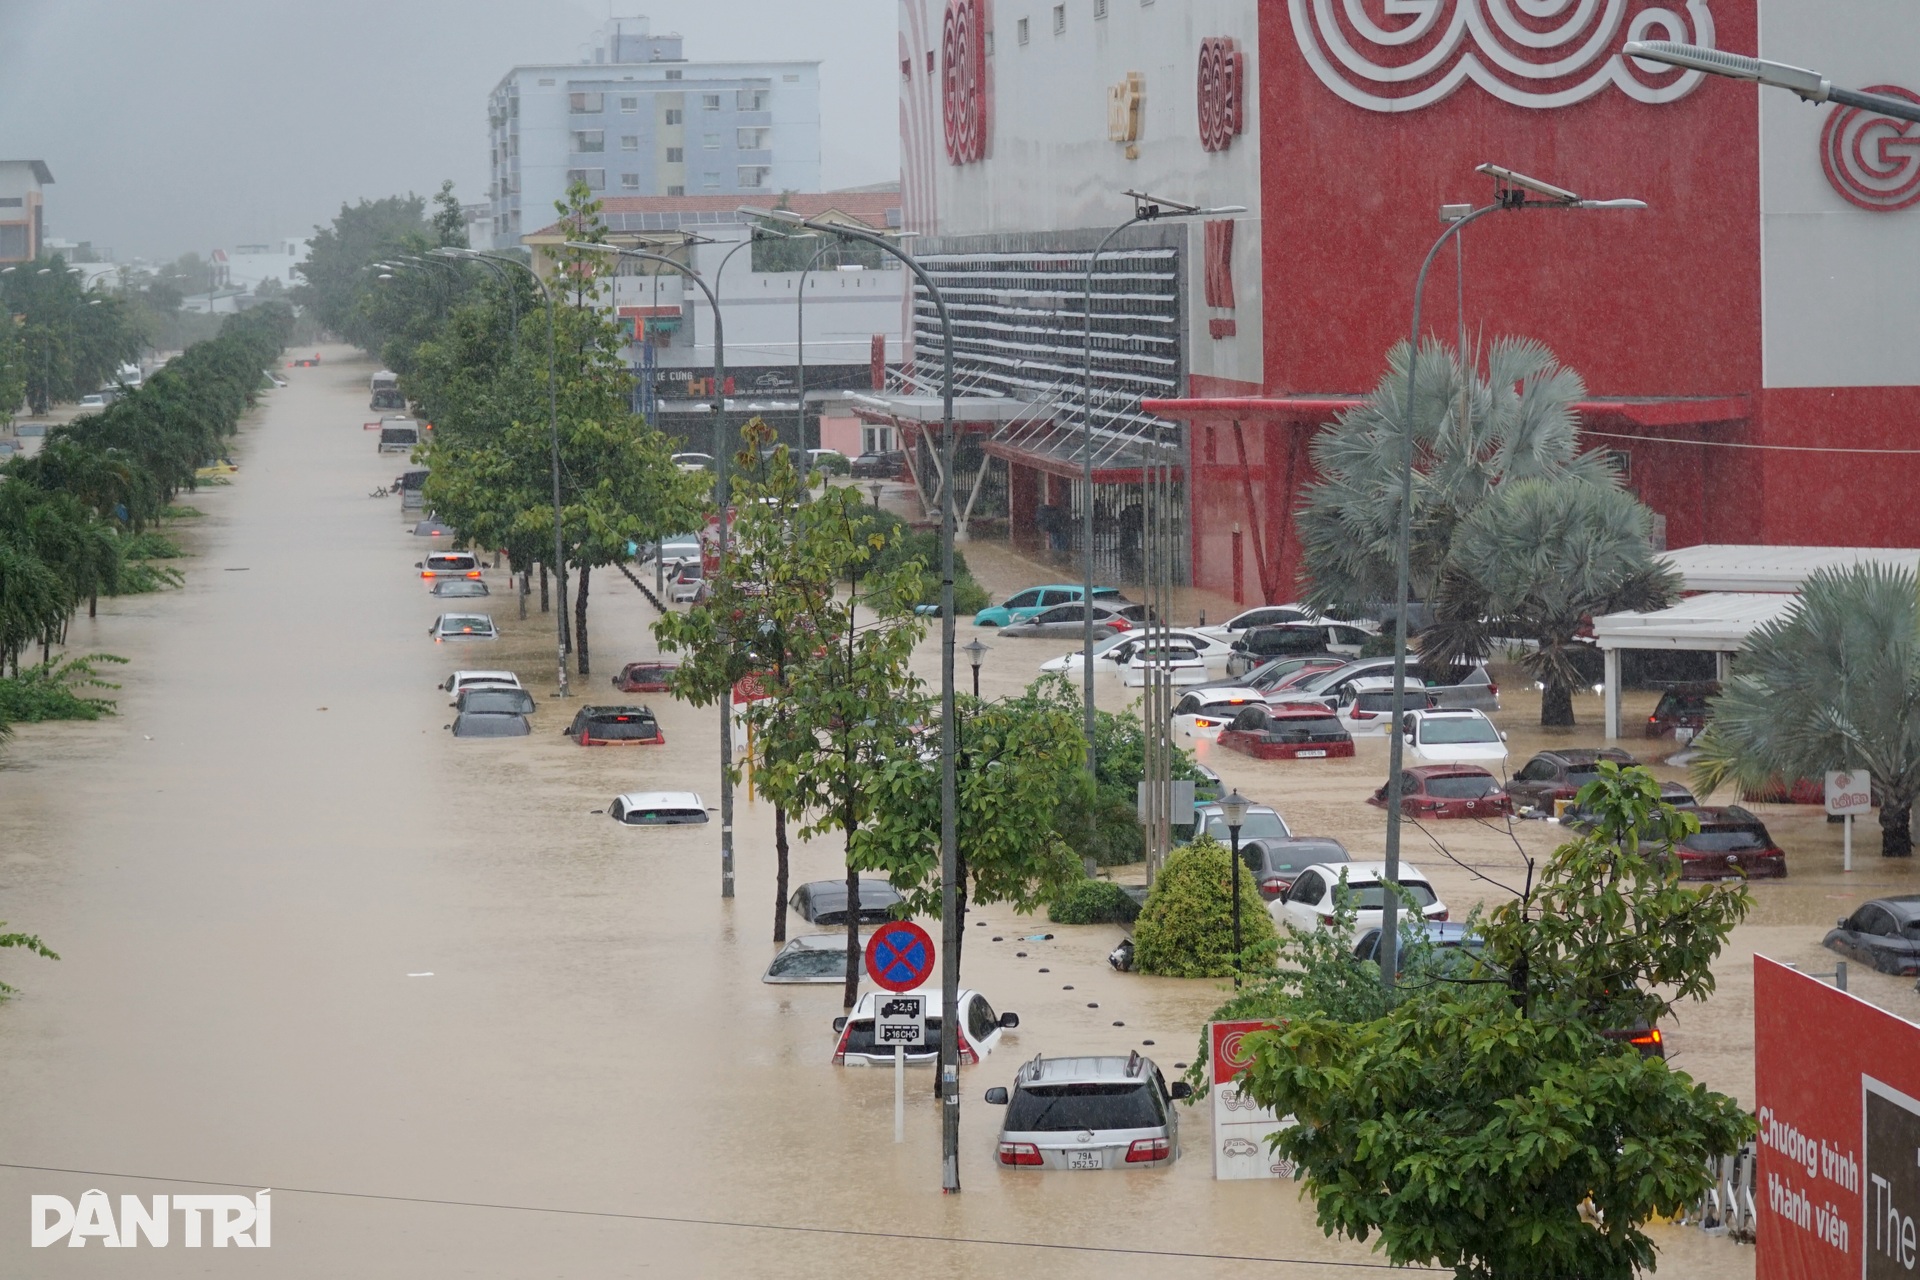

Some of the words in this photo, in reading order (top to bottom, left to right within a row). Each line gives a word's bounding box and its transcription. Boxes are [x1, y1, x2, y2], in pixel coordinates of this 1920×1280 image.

[1851, 793, 1869, 806] Ra
[1071, 1160, 1099, 1169] 352.57
[1077, 1152, 1093, 1160] 79A
[1759, 1106, 1817, 1178] Chương
[1821, 1139, 1858, 1195] trình
[1768, 1173, 1811, 1232] thành
[1815, 1201, 1848, 1254] viên
[1871, 1172, 1917, 1270] The
